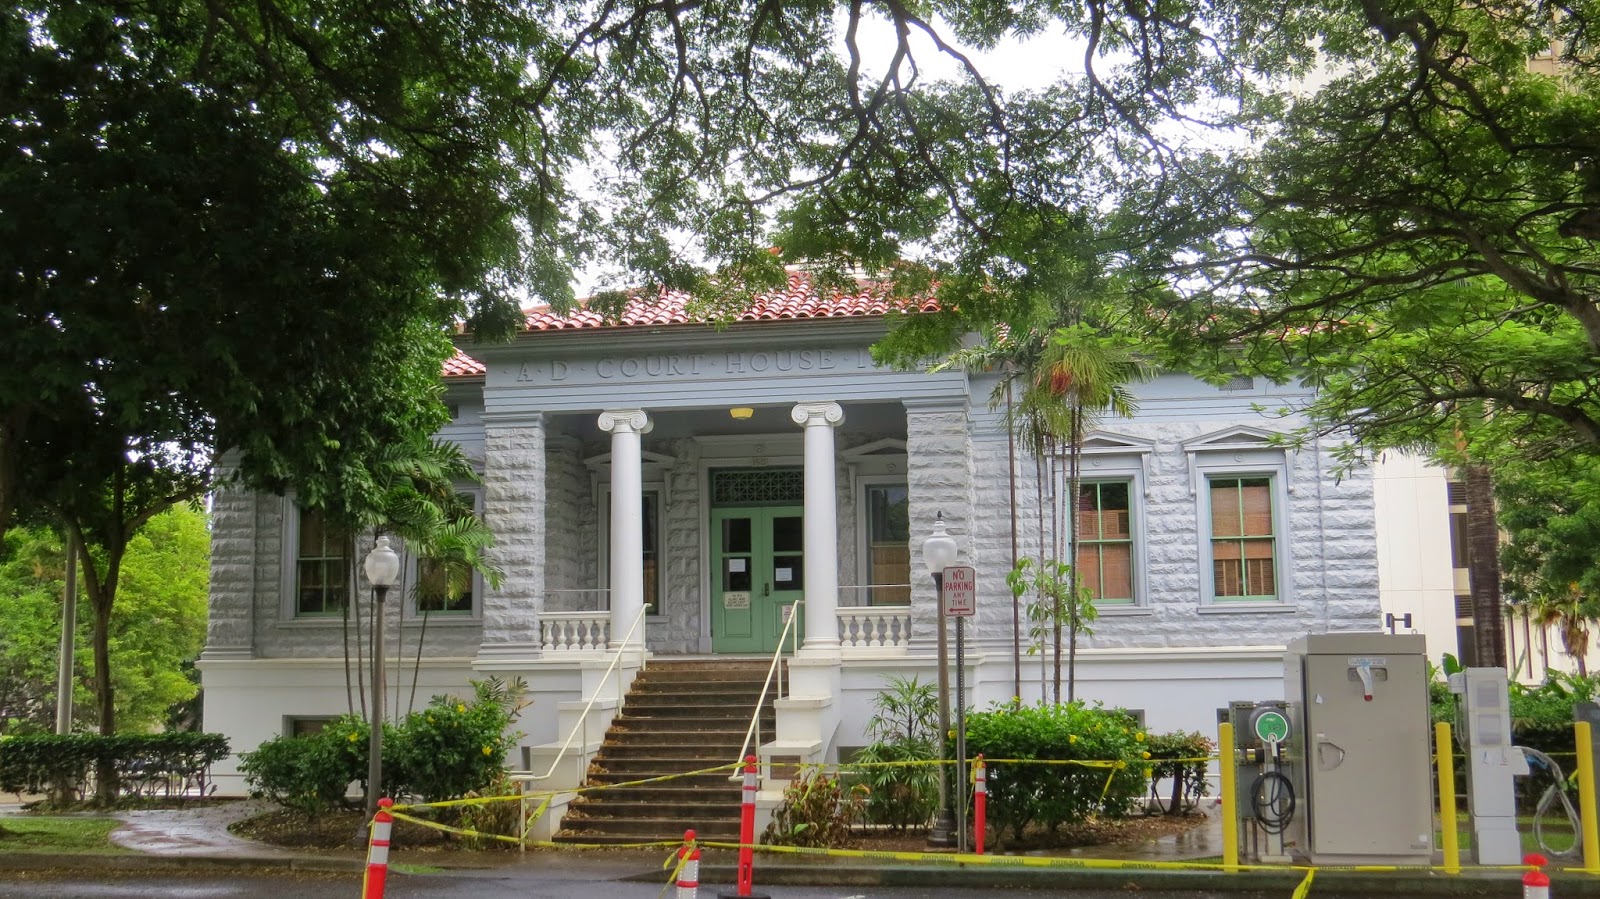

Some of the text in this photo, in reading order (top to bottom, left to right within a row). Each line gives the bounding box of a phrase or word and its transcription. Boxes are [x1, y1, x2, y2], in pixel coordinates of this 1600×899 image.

[516, 360, 533, 382] A
[551, 360, 568, 381] D
[596, 354, 704, 379] COURT
[725, 349, 838, 374] HOUSE
[952, 571, 965, 580] NO
[945, 581, 973, 591] PARKING
